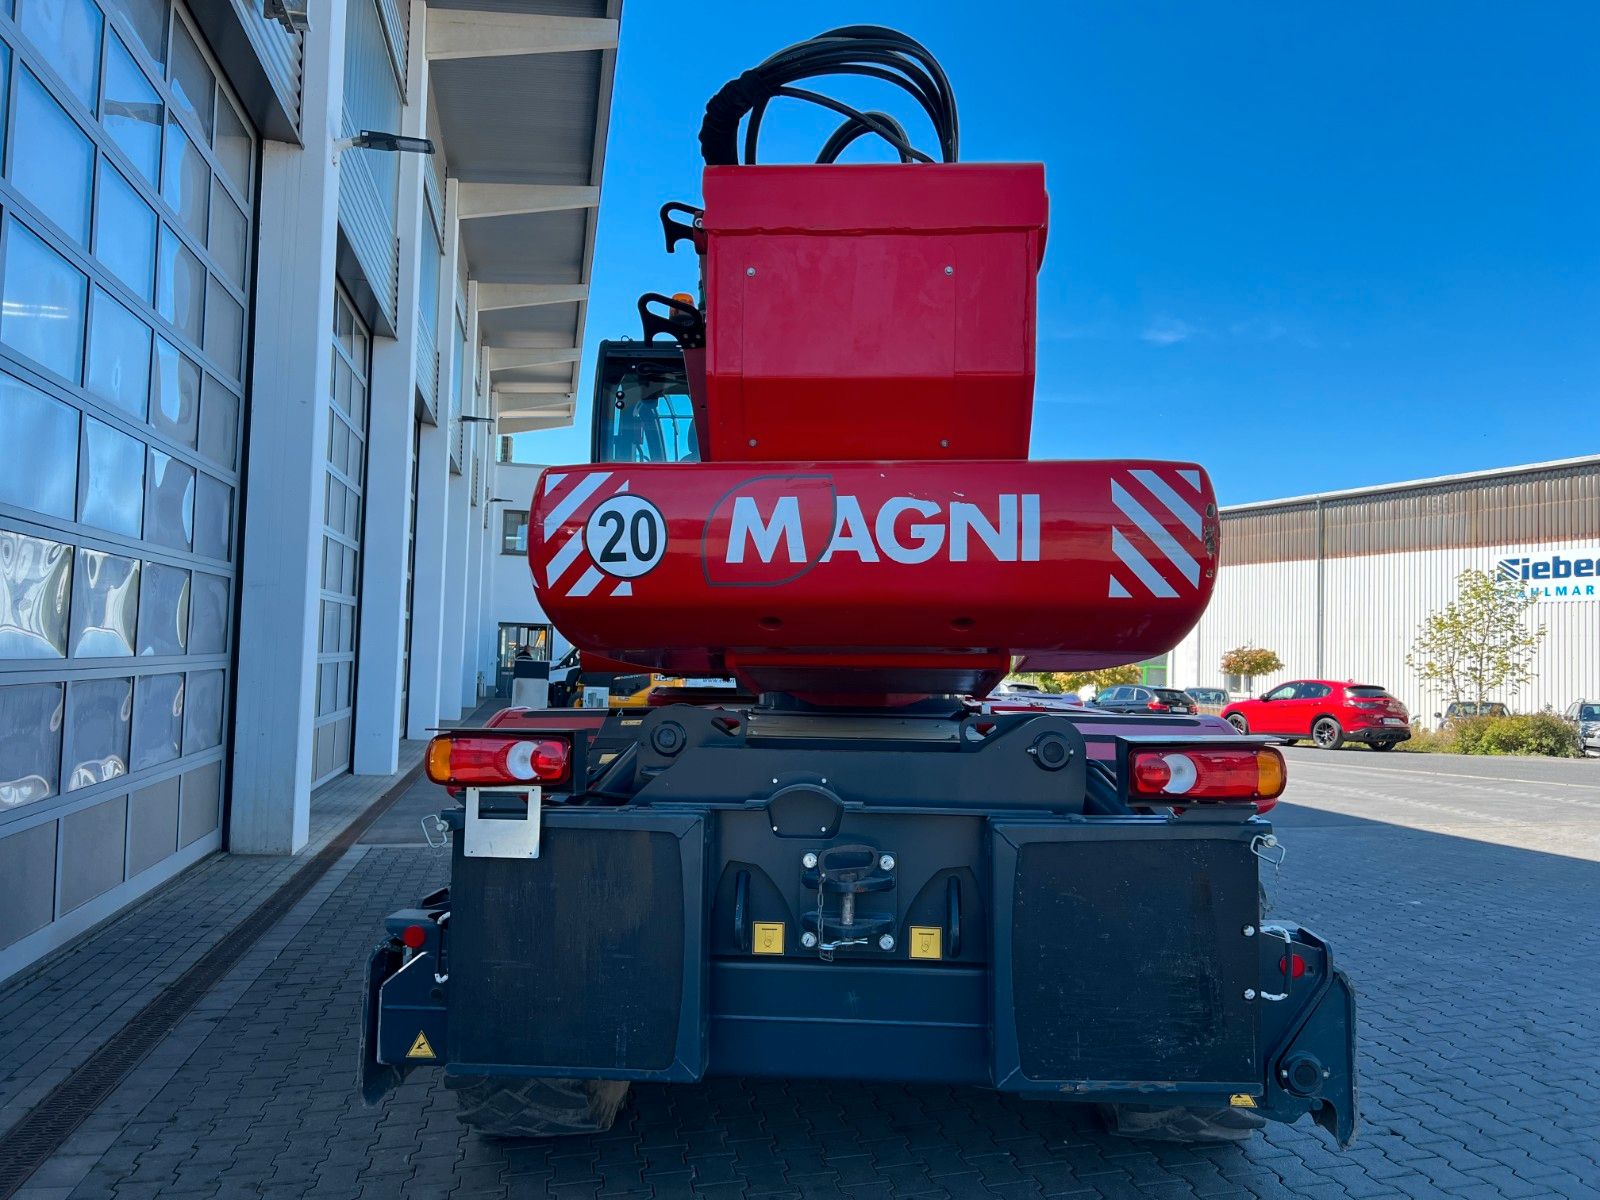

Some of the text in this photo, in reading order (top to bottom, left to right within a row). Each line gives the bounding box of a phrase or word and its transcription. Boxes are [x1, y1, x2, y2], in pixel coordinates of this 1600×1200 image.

[598, 509, 658, 563] 20
[725, 494, 1041, 565] MAGNI
[1496, 555, 1600, 582] Siebe
